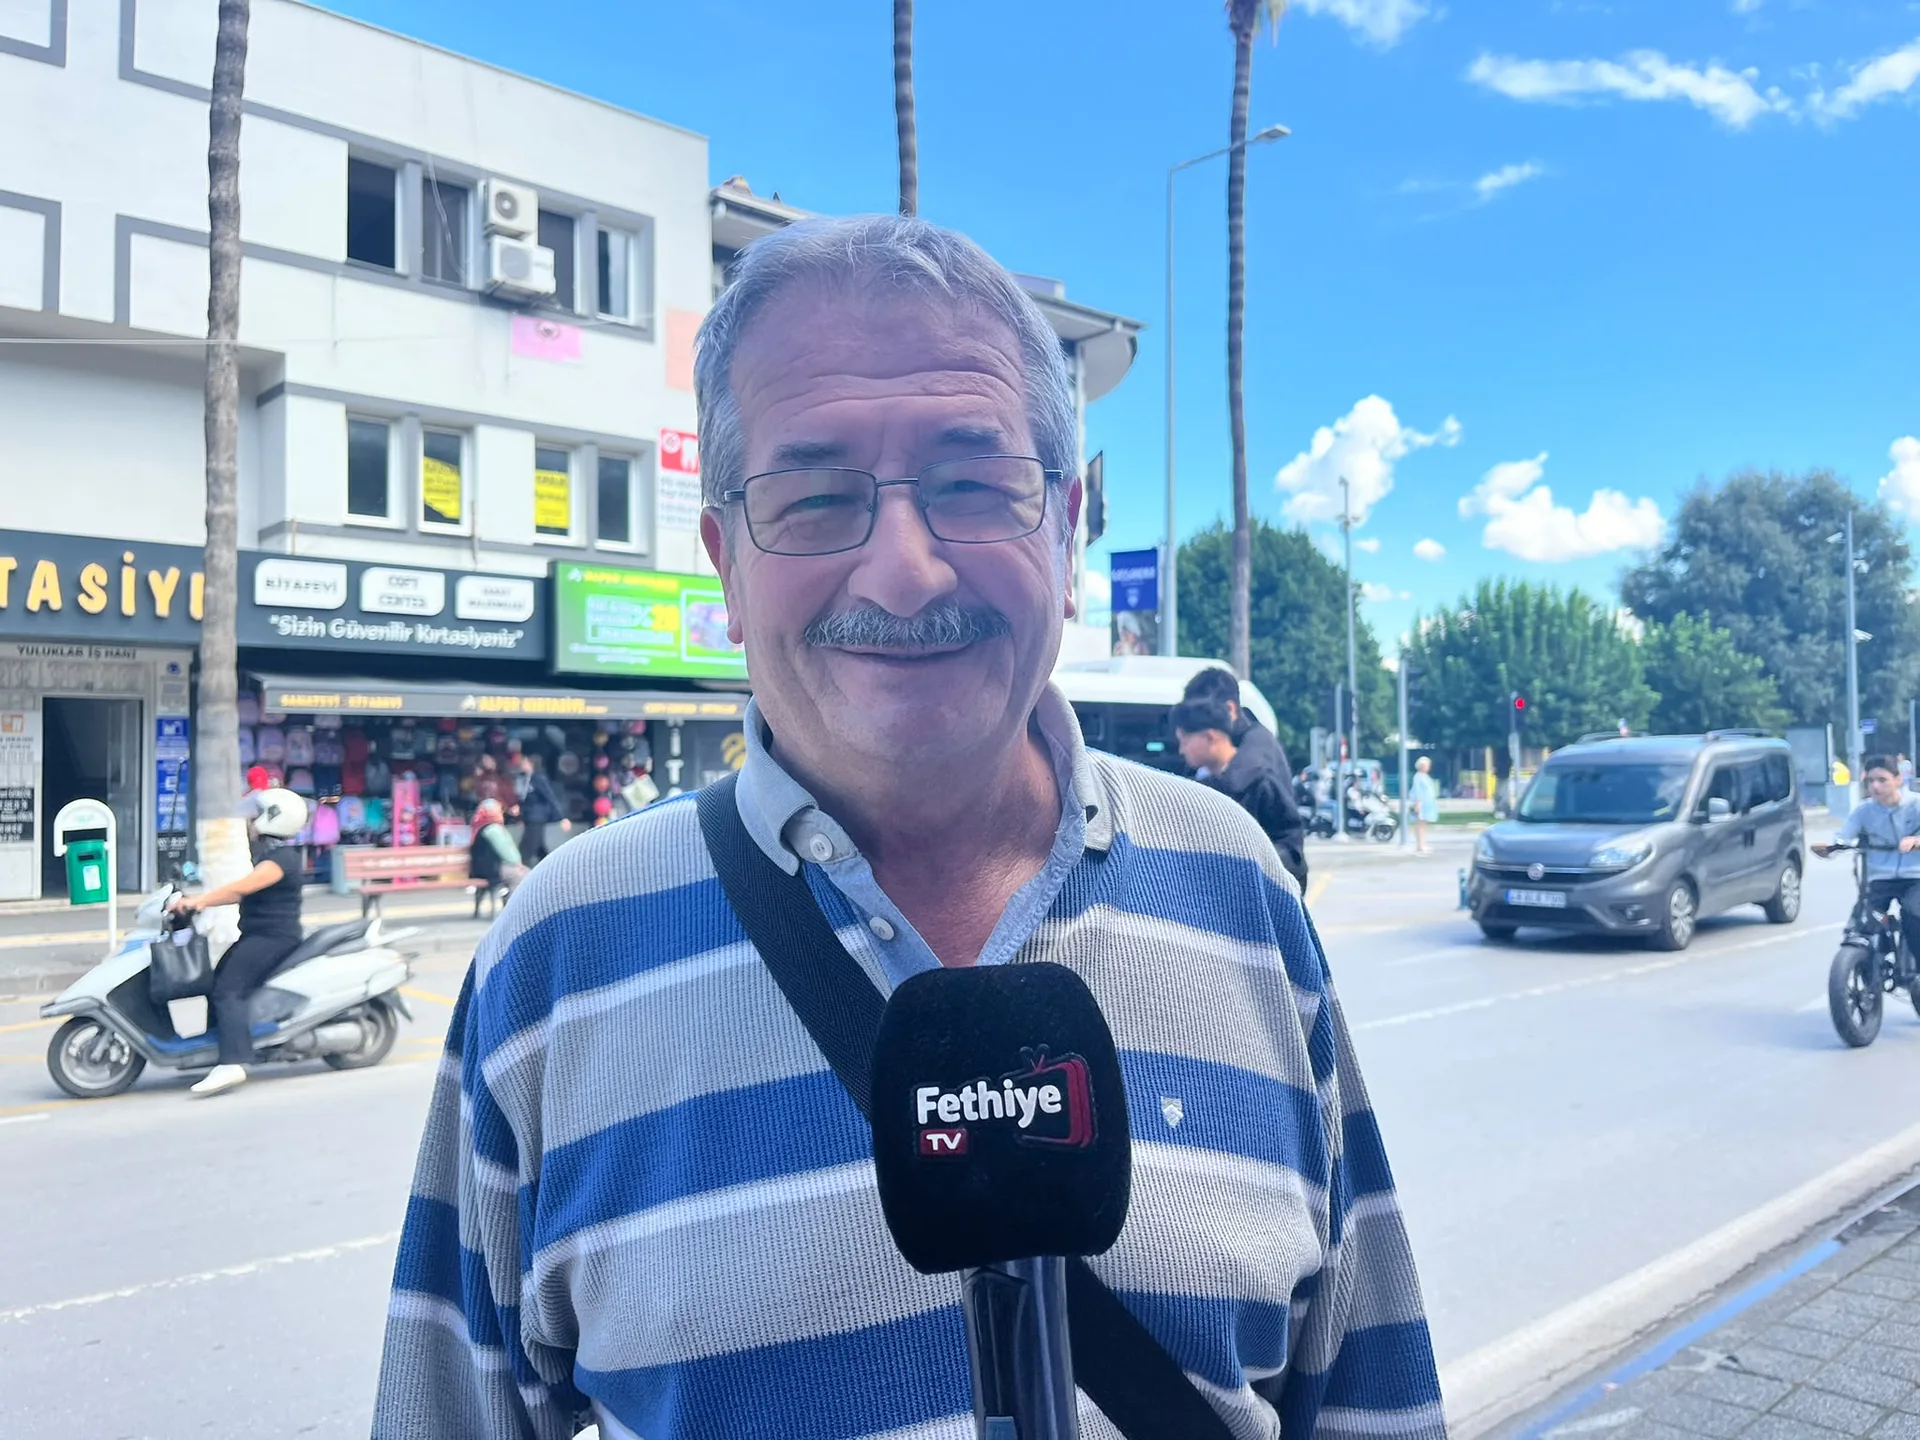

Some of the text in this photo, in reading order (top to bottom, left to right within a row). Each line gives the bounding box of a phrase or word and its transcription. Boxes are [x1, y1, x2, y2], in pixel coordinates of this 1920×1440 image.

[329, 617, 413, 642] Güvenilir
[916, 1079, 1062, 1128] Fethiye
[926, 1132, 962, 1151] TV
